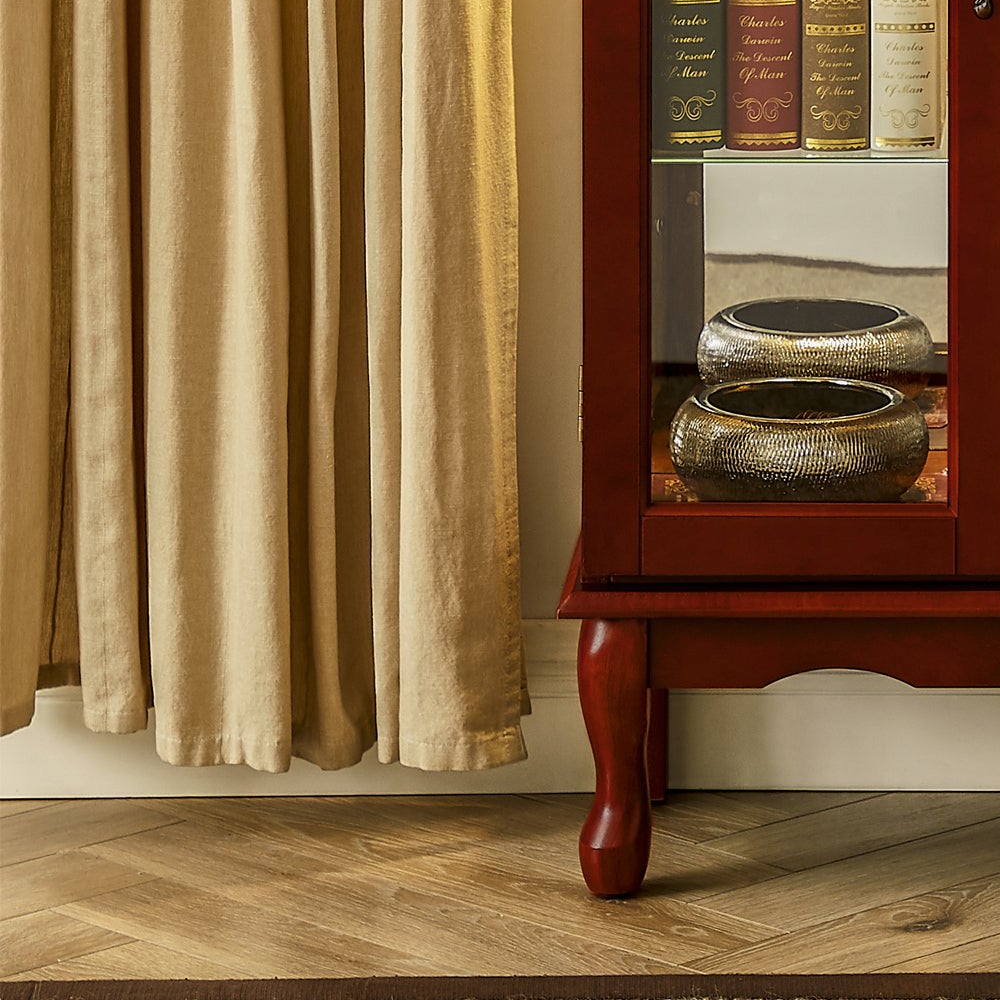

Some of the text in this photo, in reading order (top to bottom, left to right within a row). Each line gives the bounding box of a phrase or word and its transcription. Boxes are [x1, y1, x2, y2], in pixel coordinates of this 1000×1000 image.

[664, 14, 708, 26] harles
[739, 14, 785, 28] Charles
[741, 35, 782, 45] Darwin
[884, 40, 924, 51] Charles
[815, 43, 856, 53] Charles
[675, 50, 716, 61] Descent
[732, 51, 793, 62] The Descent
[818, 59, 853, 68] Darwin
[677, 65, 708, 78] Man
[738, 66, 785, 84] Of Man
[828, 72, 861, 82] Descent
[816, 85, 855, 99] Of Man
